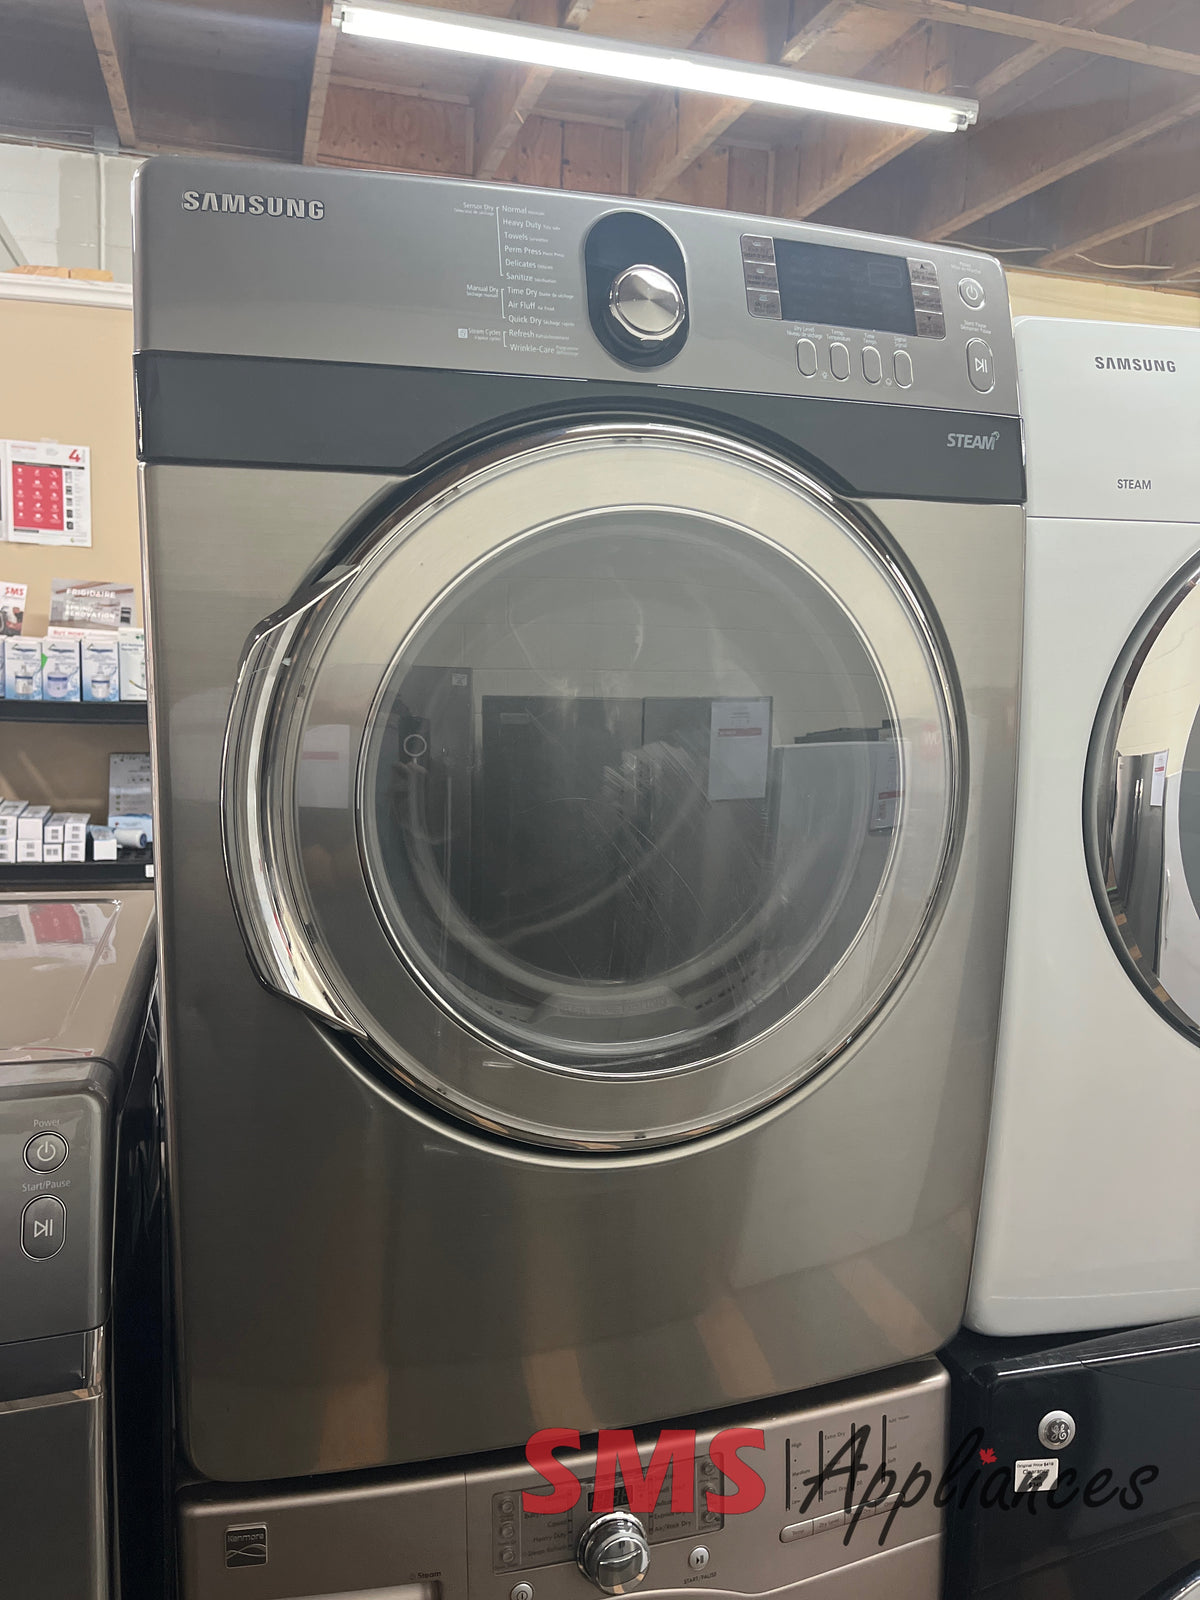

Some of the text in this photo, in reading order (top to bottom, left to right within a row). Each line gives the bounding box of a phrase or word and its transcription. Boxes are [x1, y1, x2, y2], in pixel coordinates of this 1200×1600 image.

[183, 190, 325, 220] SAMSUNG
[484, 204, 494, 212] Dry
[502, 205, 527, 215] Normal
[502, 218, 523, 229] Heavy
[526, 220, 541, 230] Duty
[504, 232, 528, 241] Towels
[505, 245, 522, 254] Perm
[524, 247, 541, 256] Press
[505, 259, 536, 269] Delicates
[506, 273, 533, 282] Sanitize
[467, 284, 499, 293] Manual Dry
[507, 286, 524, 295] Time
[526, 288, 537, 298] Dry
[508, 300, 518, 309] Air
[520, 301, 535, 310] Fluff
[508, 315, 528, 324] Quick
[530, 316, 542, 326] Dry
[509, 329, 535, 338] Refresh
[510, 344, 555, 354] Wrinkle-Care
[1094, 356, 1176, 373] SAMSUNG
[947, 431, 999, 450] STEAM
[69, 449, 81, 463] 4
[1117, 479, 1152, 489] STEAM
[5, 587, 24, 596] SMS
[66, 588, 116, 599] FRIGIDAIRE
[34, 1119, 60, 1128] Power
[22, 1179, 71, 1193] Start/Pause
[227, 1533, 265, 1542] Kenmore
